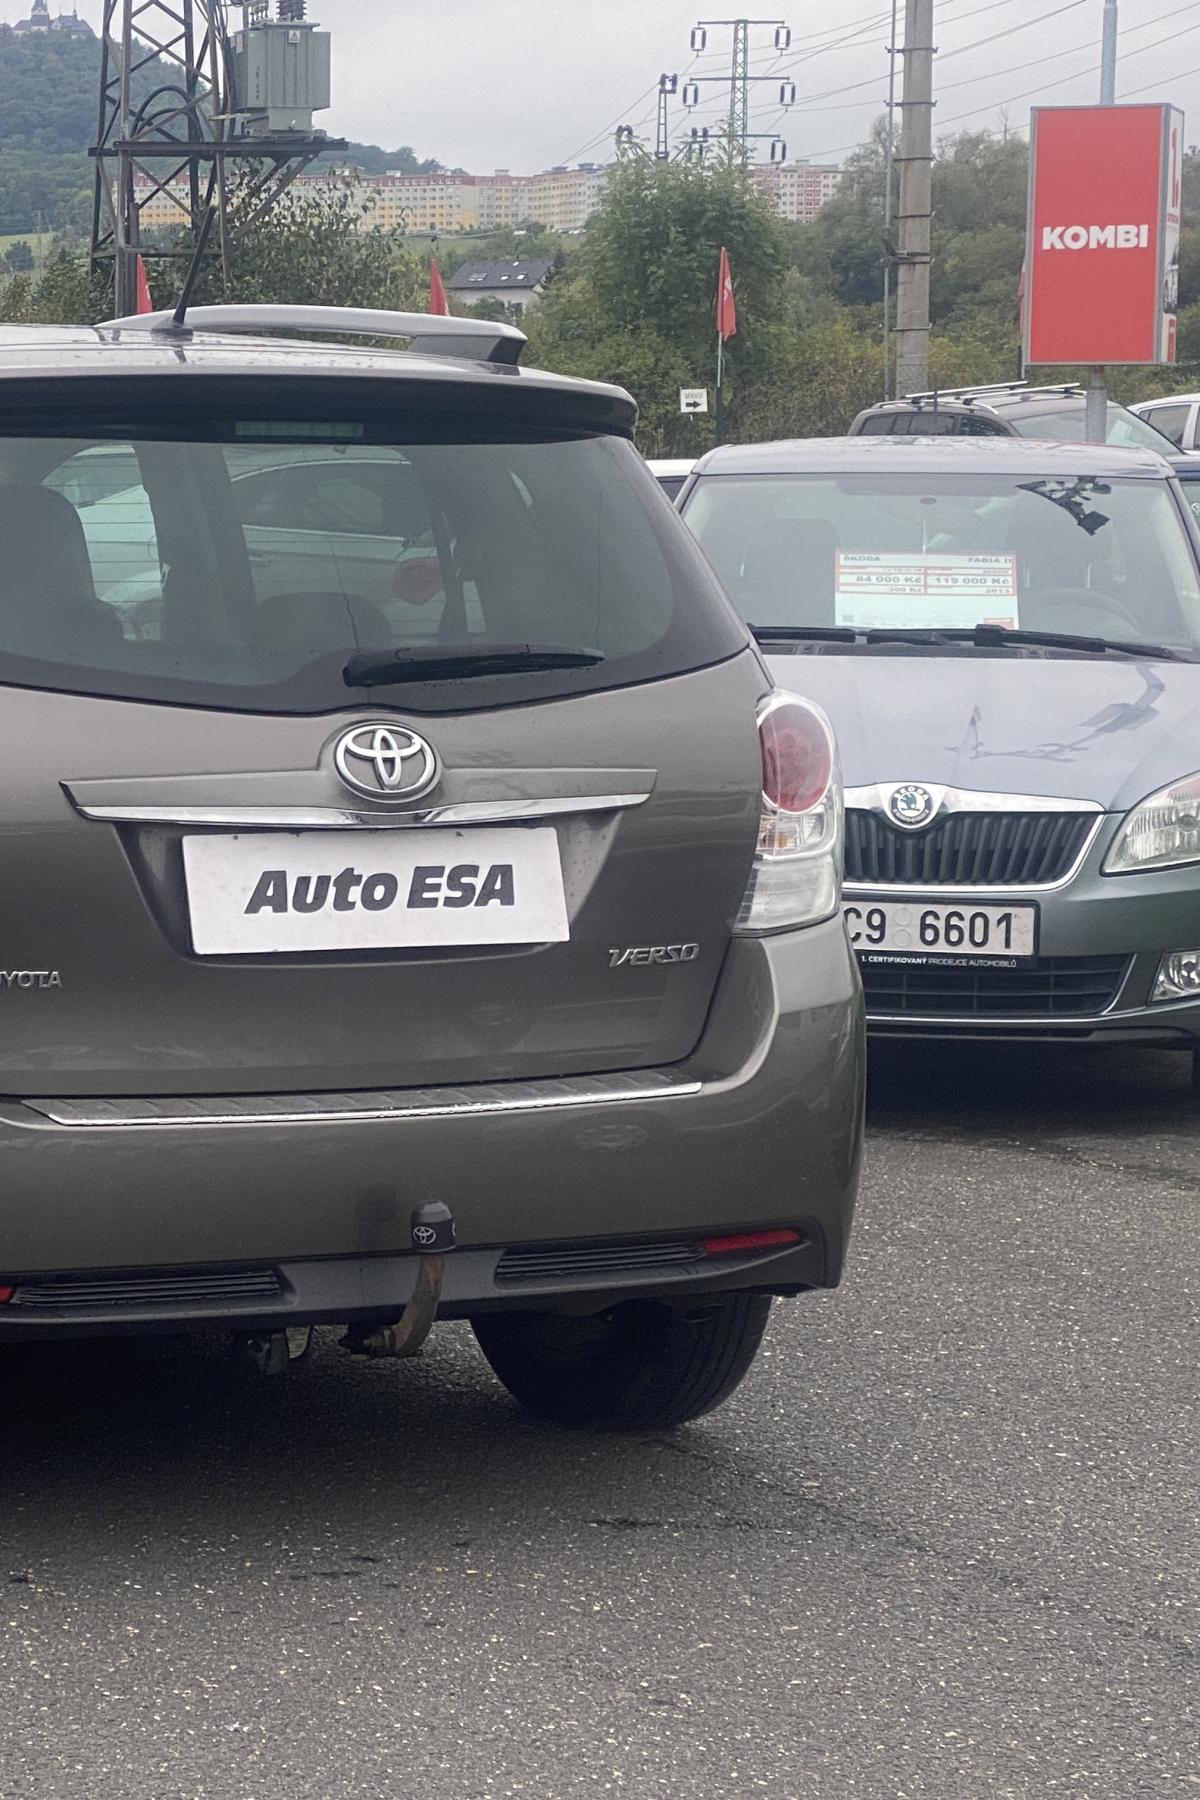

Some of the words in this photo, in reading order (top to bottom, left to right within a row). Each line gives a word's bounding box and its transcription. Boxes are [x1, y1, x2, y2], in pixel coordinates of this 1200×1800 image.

[1042, 224, 1149, 250] KOMBI
[244, 867, 398, 914] Auto
[406, 864, 514, 909] ESA
[919, 910, 1013, 949] 6601
[609, 943, 699, 968] VERSO
[868, 956, 927, 964] CERTIFIKOVANÝ
[928, 958, 968, 966] PRODEJCE
